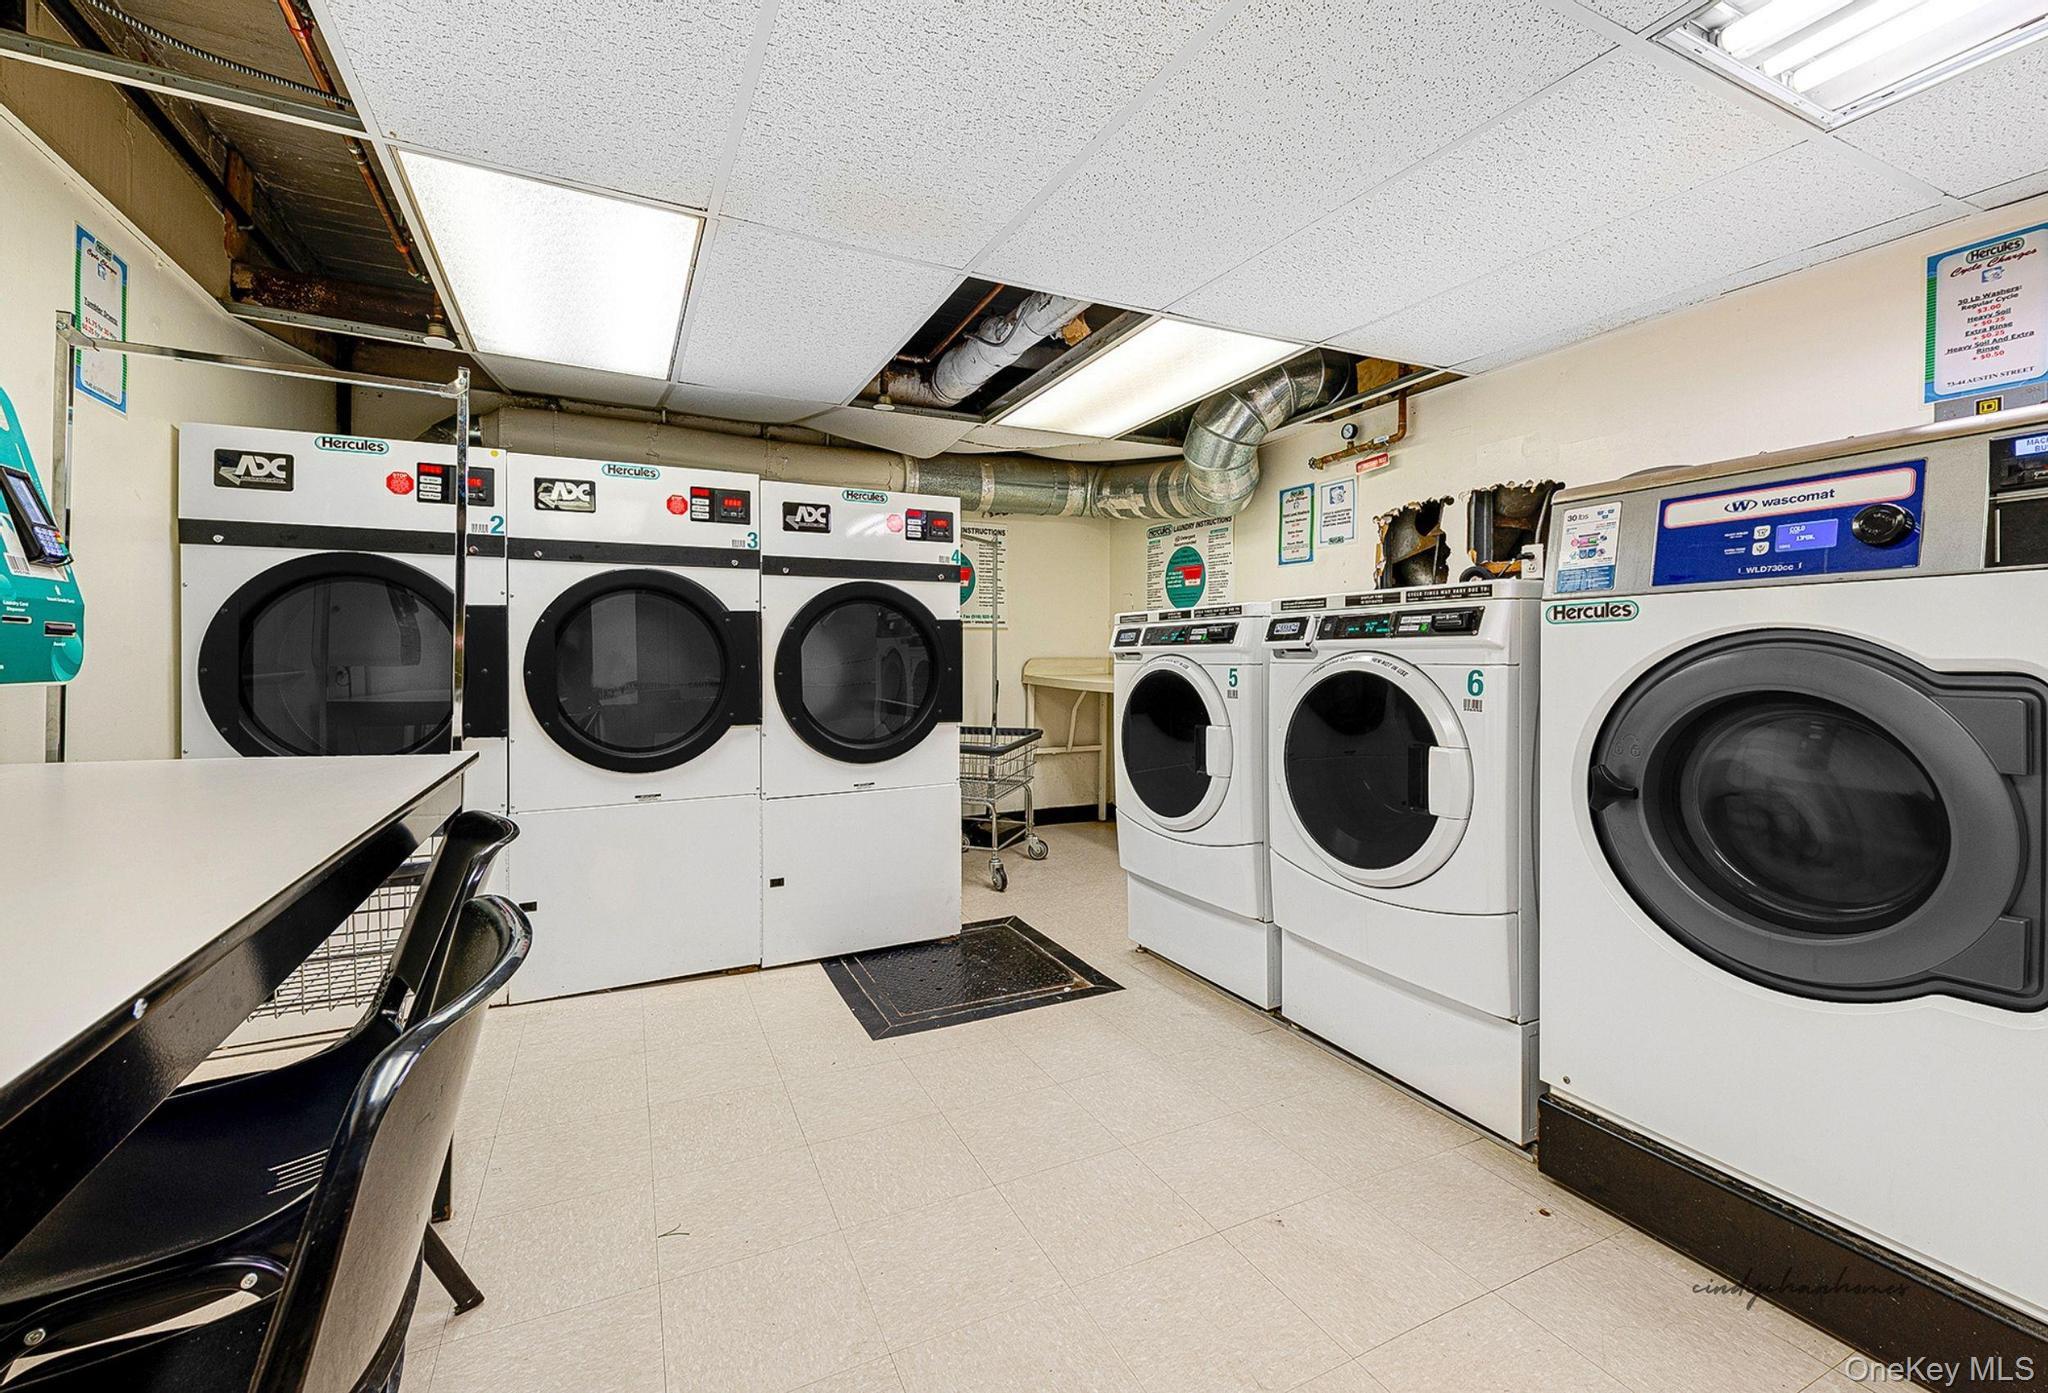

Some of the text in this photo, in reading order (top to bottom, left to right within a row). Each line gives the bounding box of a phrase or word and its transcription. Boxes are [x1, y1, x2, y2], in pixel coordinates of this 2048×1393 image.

[1970, 239, 2020, 261] Hercules
[1950, 248, 2037, 278] Cycle Charges
[1983, 285, 2022, 299] Washers:
[1961, 293, 2019, 311] Regular Cycle
[1977, 303, 2001, 314] $3.00
[1967, 307, 2012, 324] Heavy Soil
[1982, 316, 2006, 326] $0.25
[1965, 322, 2013, 337] Extra Rinse
[1981, 330, 2005, 339] $0.25
[1946, 331, 2035, 354] Heavy Soil And Extra
[1976, 345, 2000, 354] Rinse
[1981, 350, 2005, 360] $0.50
[1966, 373, 1998, 383] AUSTIN
[2000, 366, 2034, 377] STREET
[322, 436, 384, 452] Hercules
[234, 455, 286, 478] ADC
[608, 464, 656, 478] Hercules
[551, 482, 590, 501] ADC
[846, 490, 885, 502] Hercules
[1762, 489, 1835, 507] wascomat
[795, 506, 826, 523] ADC
[1568, 514, 1577, 522] 30
[490, 515, 505, 534] 2
[1174, 523, 1195, 532] LAUNDRY
[1195, 516, 1232, 528] INSTRUCTIONS
[747, 532, 758, 548] 3
[951, 550, 960, 564] 4
[1746, 564, 1793, 574] WLD730cc
[1553, 602, 1632, 620] Hercules
[1229, 668, 1238, 687] 5
[1467, 669, 1484, 696] 6
